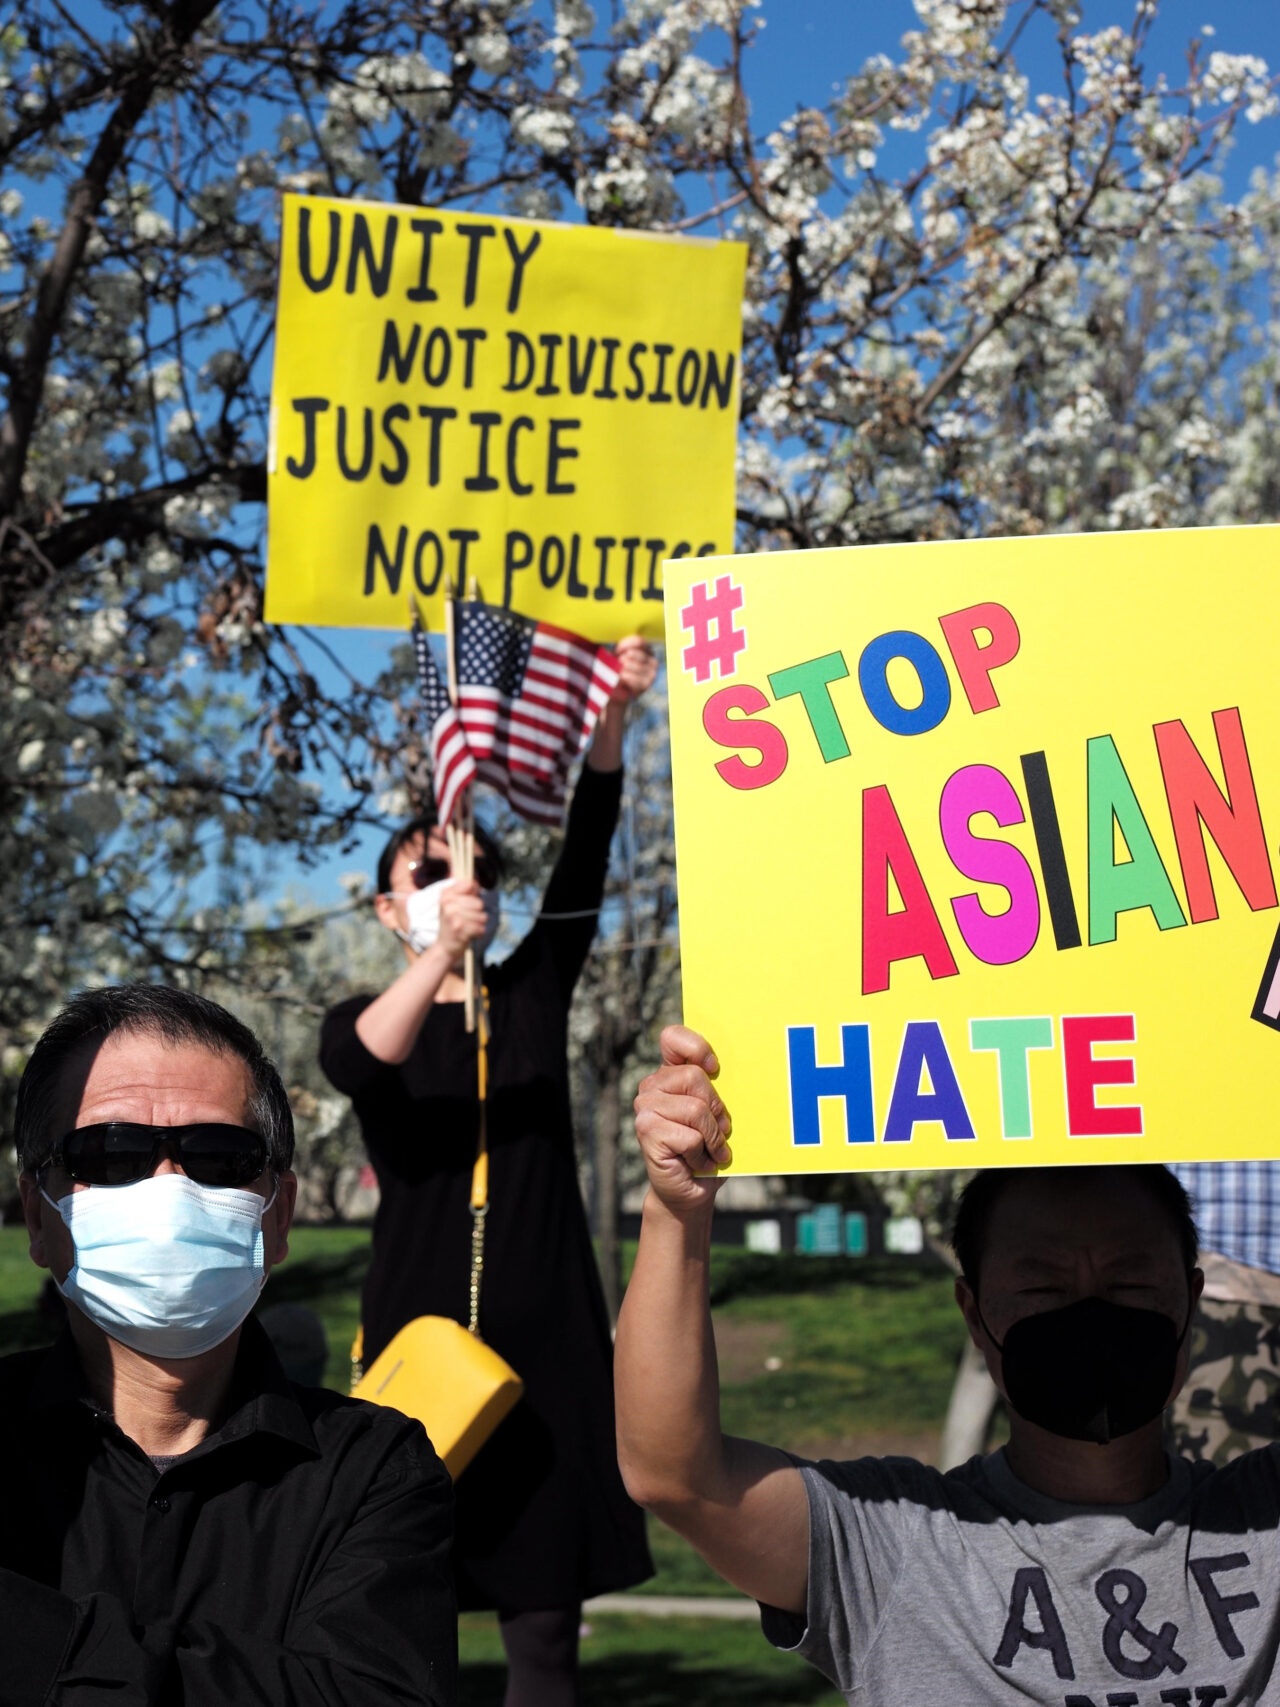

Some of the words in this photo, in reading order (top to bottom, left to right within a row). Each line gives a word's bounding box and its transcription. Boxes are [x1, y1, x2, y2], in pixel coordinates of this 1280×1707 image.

[297, 206, 542, 314] UNITY
[377, 319, 488, 390] NOT
[501, 331, 736, 410] DIVISION
[285, 397, 582, 496] JUSTICE
[363, 523, 481, 599] NOT
[861, 706, 1279, 996] ASIAN
[786, 1013, 1144, 1146] HATE
[992, 1566, 1076, 1681] A
[1188, 1551, 1261, 1660] F
